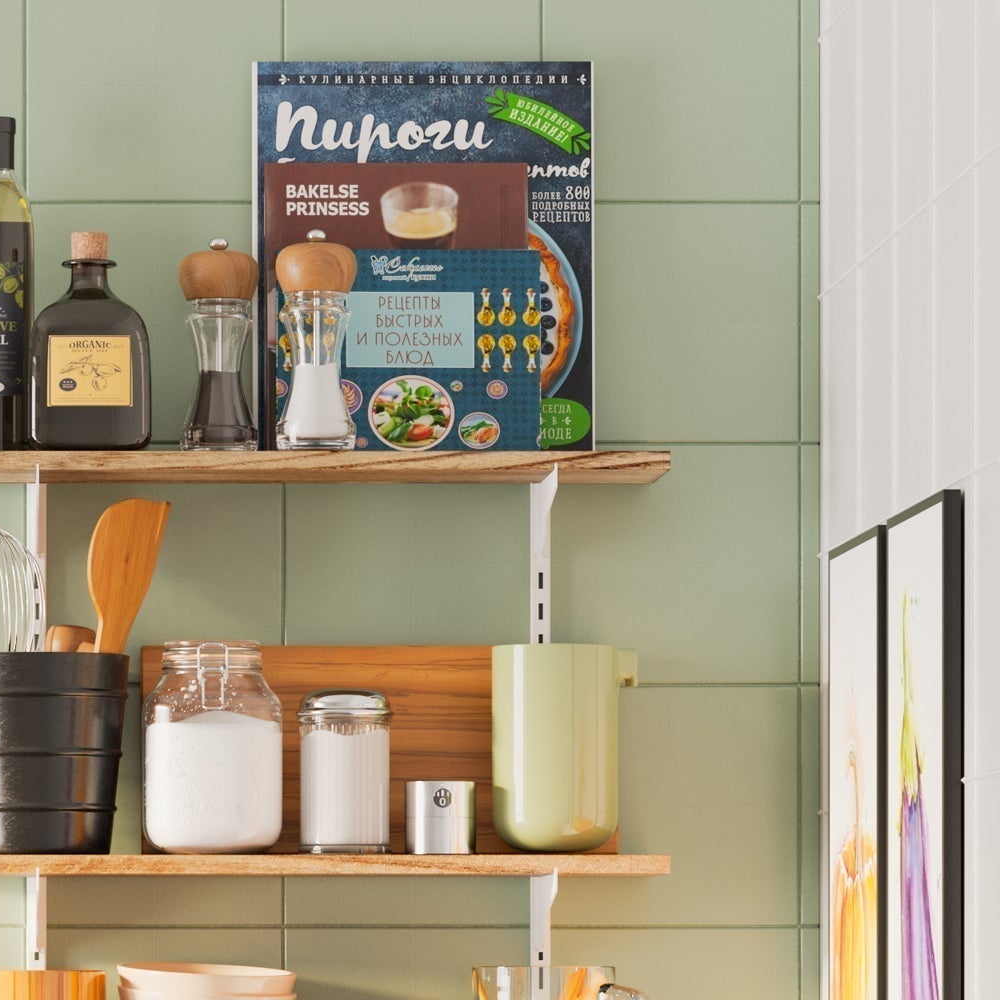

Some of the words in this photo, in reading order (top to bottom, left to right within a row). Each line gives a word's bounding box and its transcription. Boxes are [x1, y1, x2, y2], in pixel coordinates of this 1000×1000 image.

[299, 75, 415, 84] КУЛИНАРНЫЕ
[428, 75, 568, 84] ЭНЦИКЛОПЕДИИ
[516, 99, 575, 133] ЮБИЛЕЙНОЕ
[276, 101, 494, 163] Пироги
[509, 108, 569, 144] ИЗДАНИЕ!
[286, 184, 359, 199] BAKELSE
[532, 191, 562, 200] БОЛЕЕ
[565, 185, 590, 200] 800
[286, 201, 370, 216] PRINSESS
[532, 201, 590, 211] ПОДРОБНЫХ
[533, 211, 591, 223] РЕЦЕПТОВ
[378, 296, 440, 312] РЕЦЕПТЫ
[376, 313, 443, 328] БЫСТРЫХ
[69, 339, 111, 349] ORGANIC
[356, 332, 367, 346] И
[375, 331, 463, 346] ПОЛЕЗНЫХ
[386, 350, 434, 366] БЛЮД
[542, 404, 572, 414] СЕГДА
